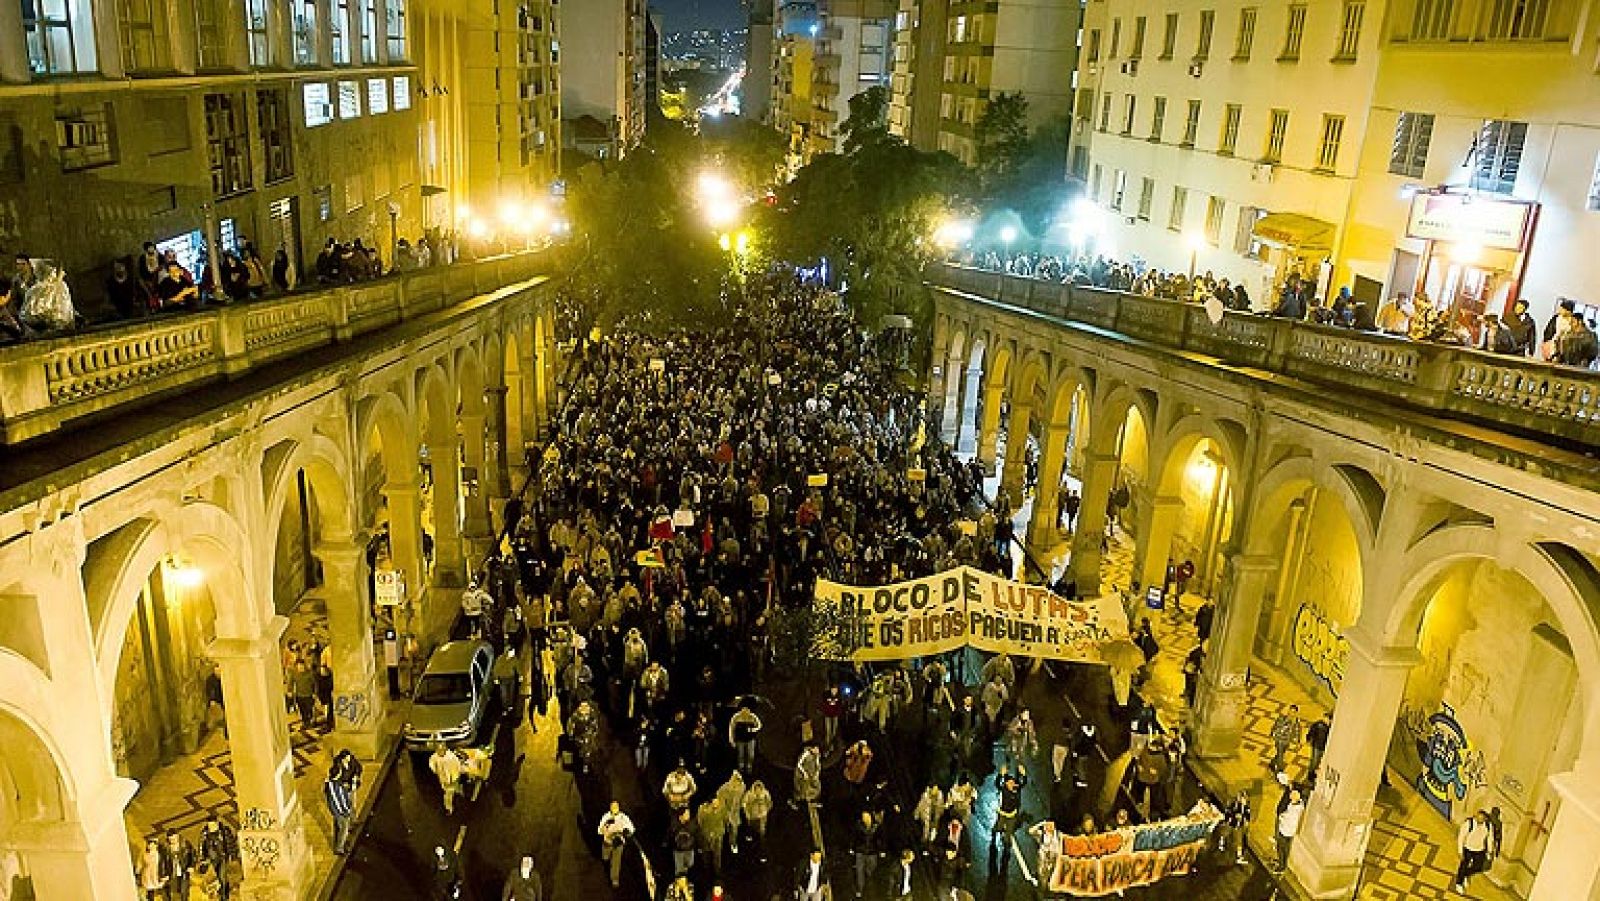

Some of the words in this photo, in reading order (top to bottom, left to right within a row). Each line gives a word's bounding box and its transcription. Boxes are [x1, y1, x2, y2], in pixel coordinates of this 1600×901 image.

[841, 584, 930, 617] BLOCO
[943, 577, 981, 604] DE
[880, 619, 903, 647] OS
[909, 611, 964, 644] RICOS
